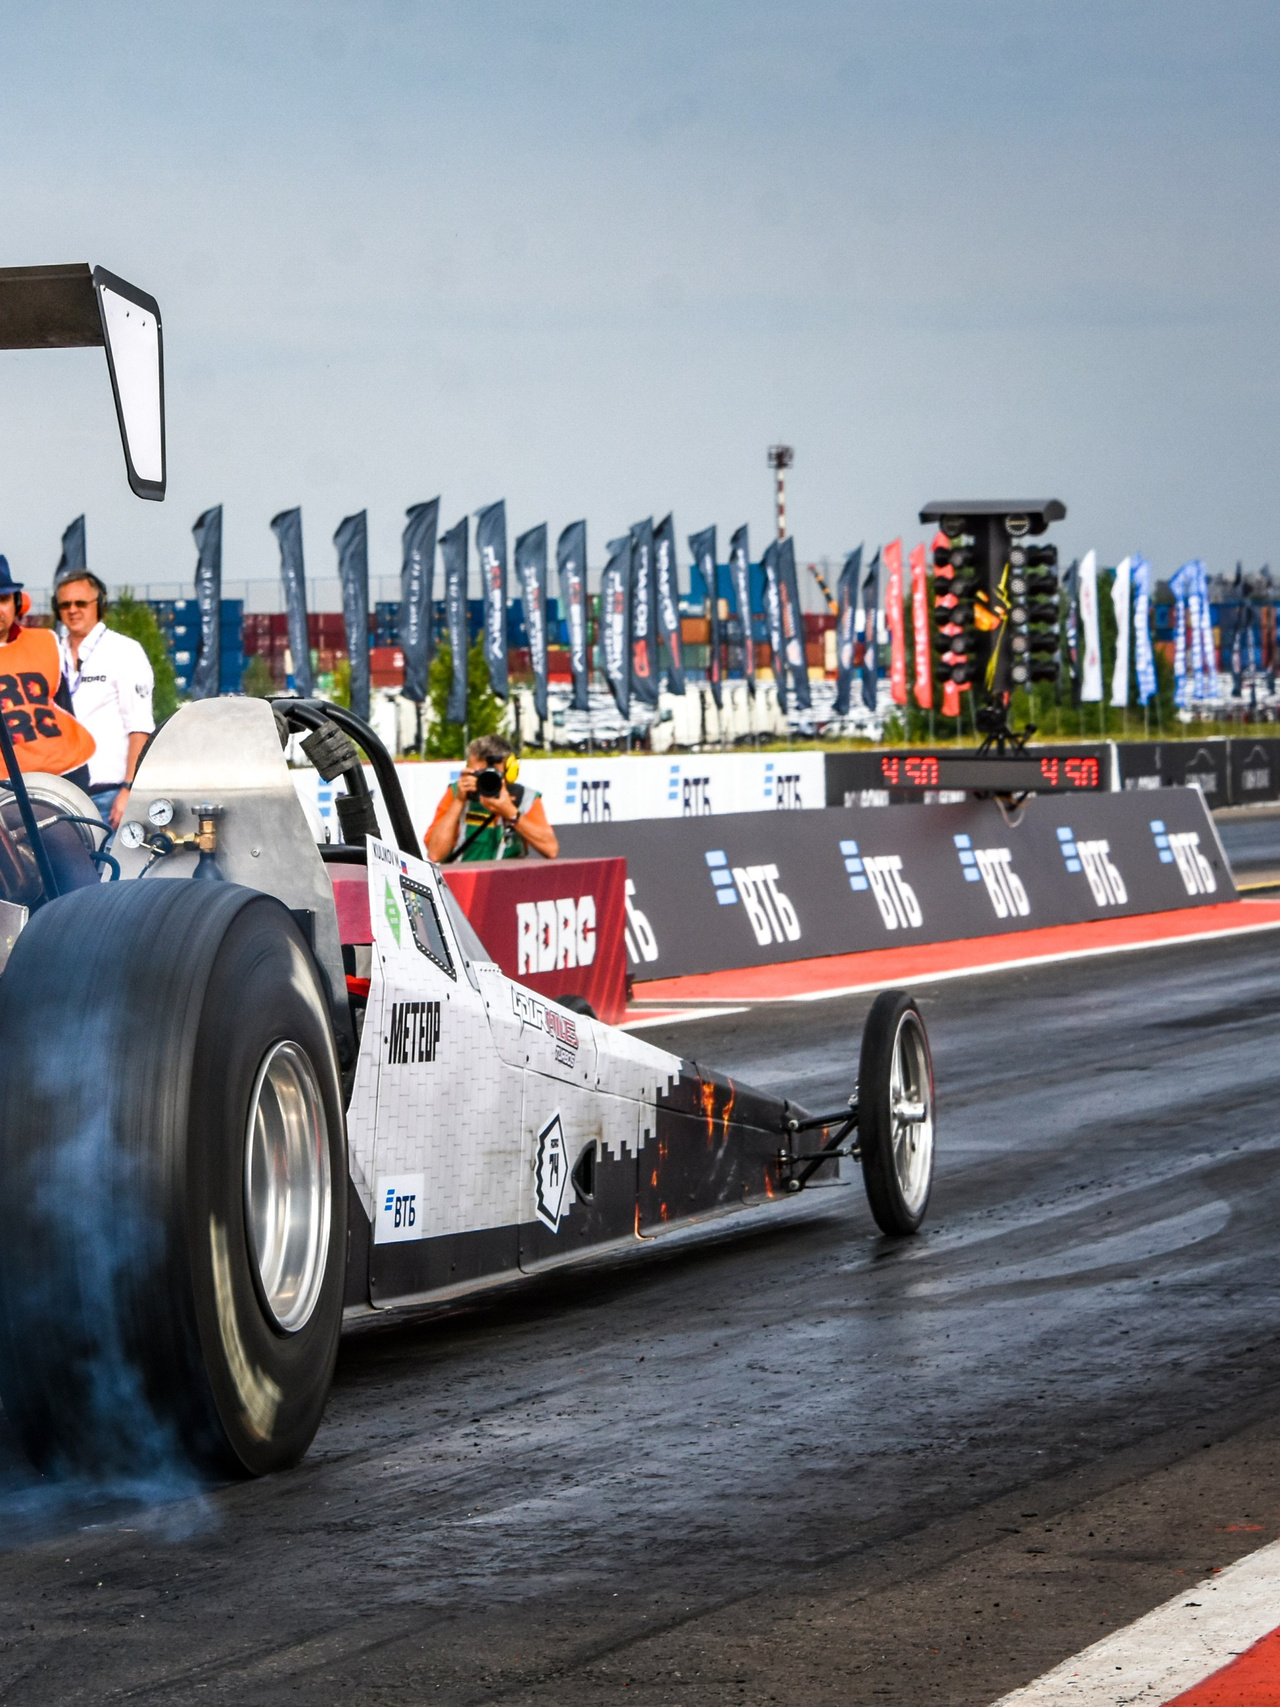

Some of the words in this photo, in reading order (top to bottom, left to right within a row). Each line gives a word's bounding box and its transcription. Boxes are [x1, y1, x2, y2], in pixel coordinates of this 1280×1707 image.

[2, 708, 62, 746] RC
[862, 855, 923, 930] ВТБ
[974, 848, 1031, 918] ВТБ
[1076, 839, 1128, 907] ВТБ
[1168, 832, 1217, 896] ВТБ
[516, 895, 596, 976] RDRC
[732, 864, 802, 946] ВТБ
[394, 1195, 416, 1227] ВТБ
